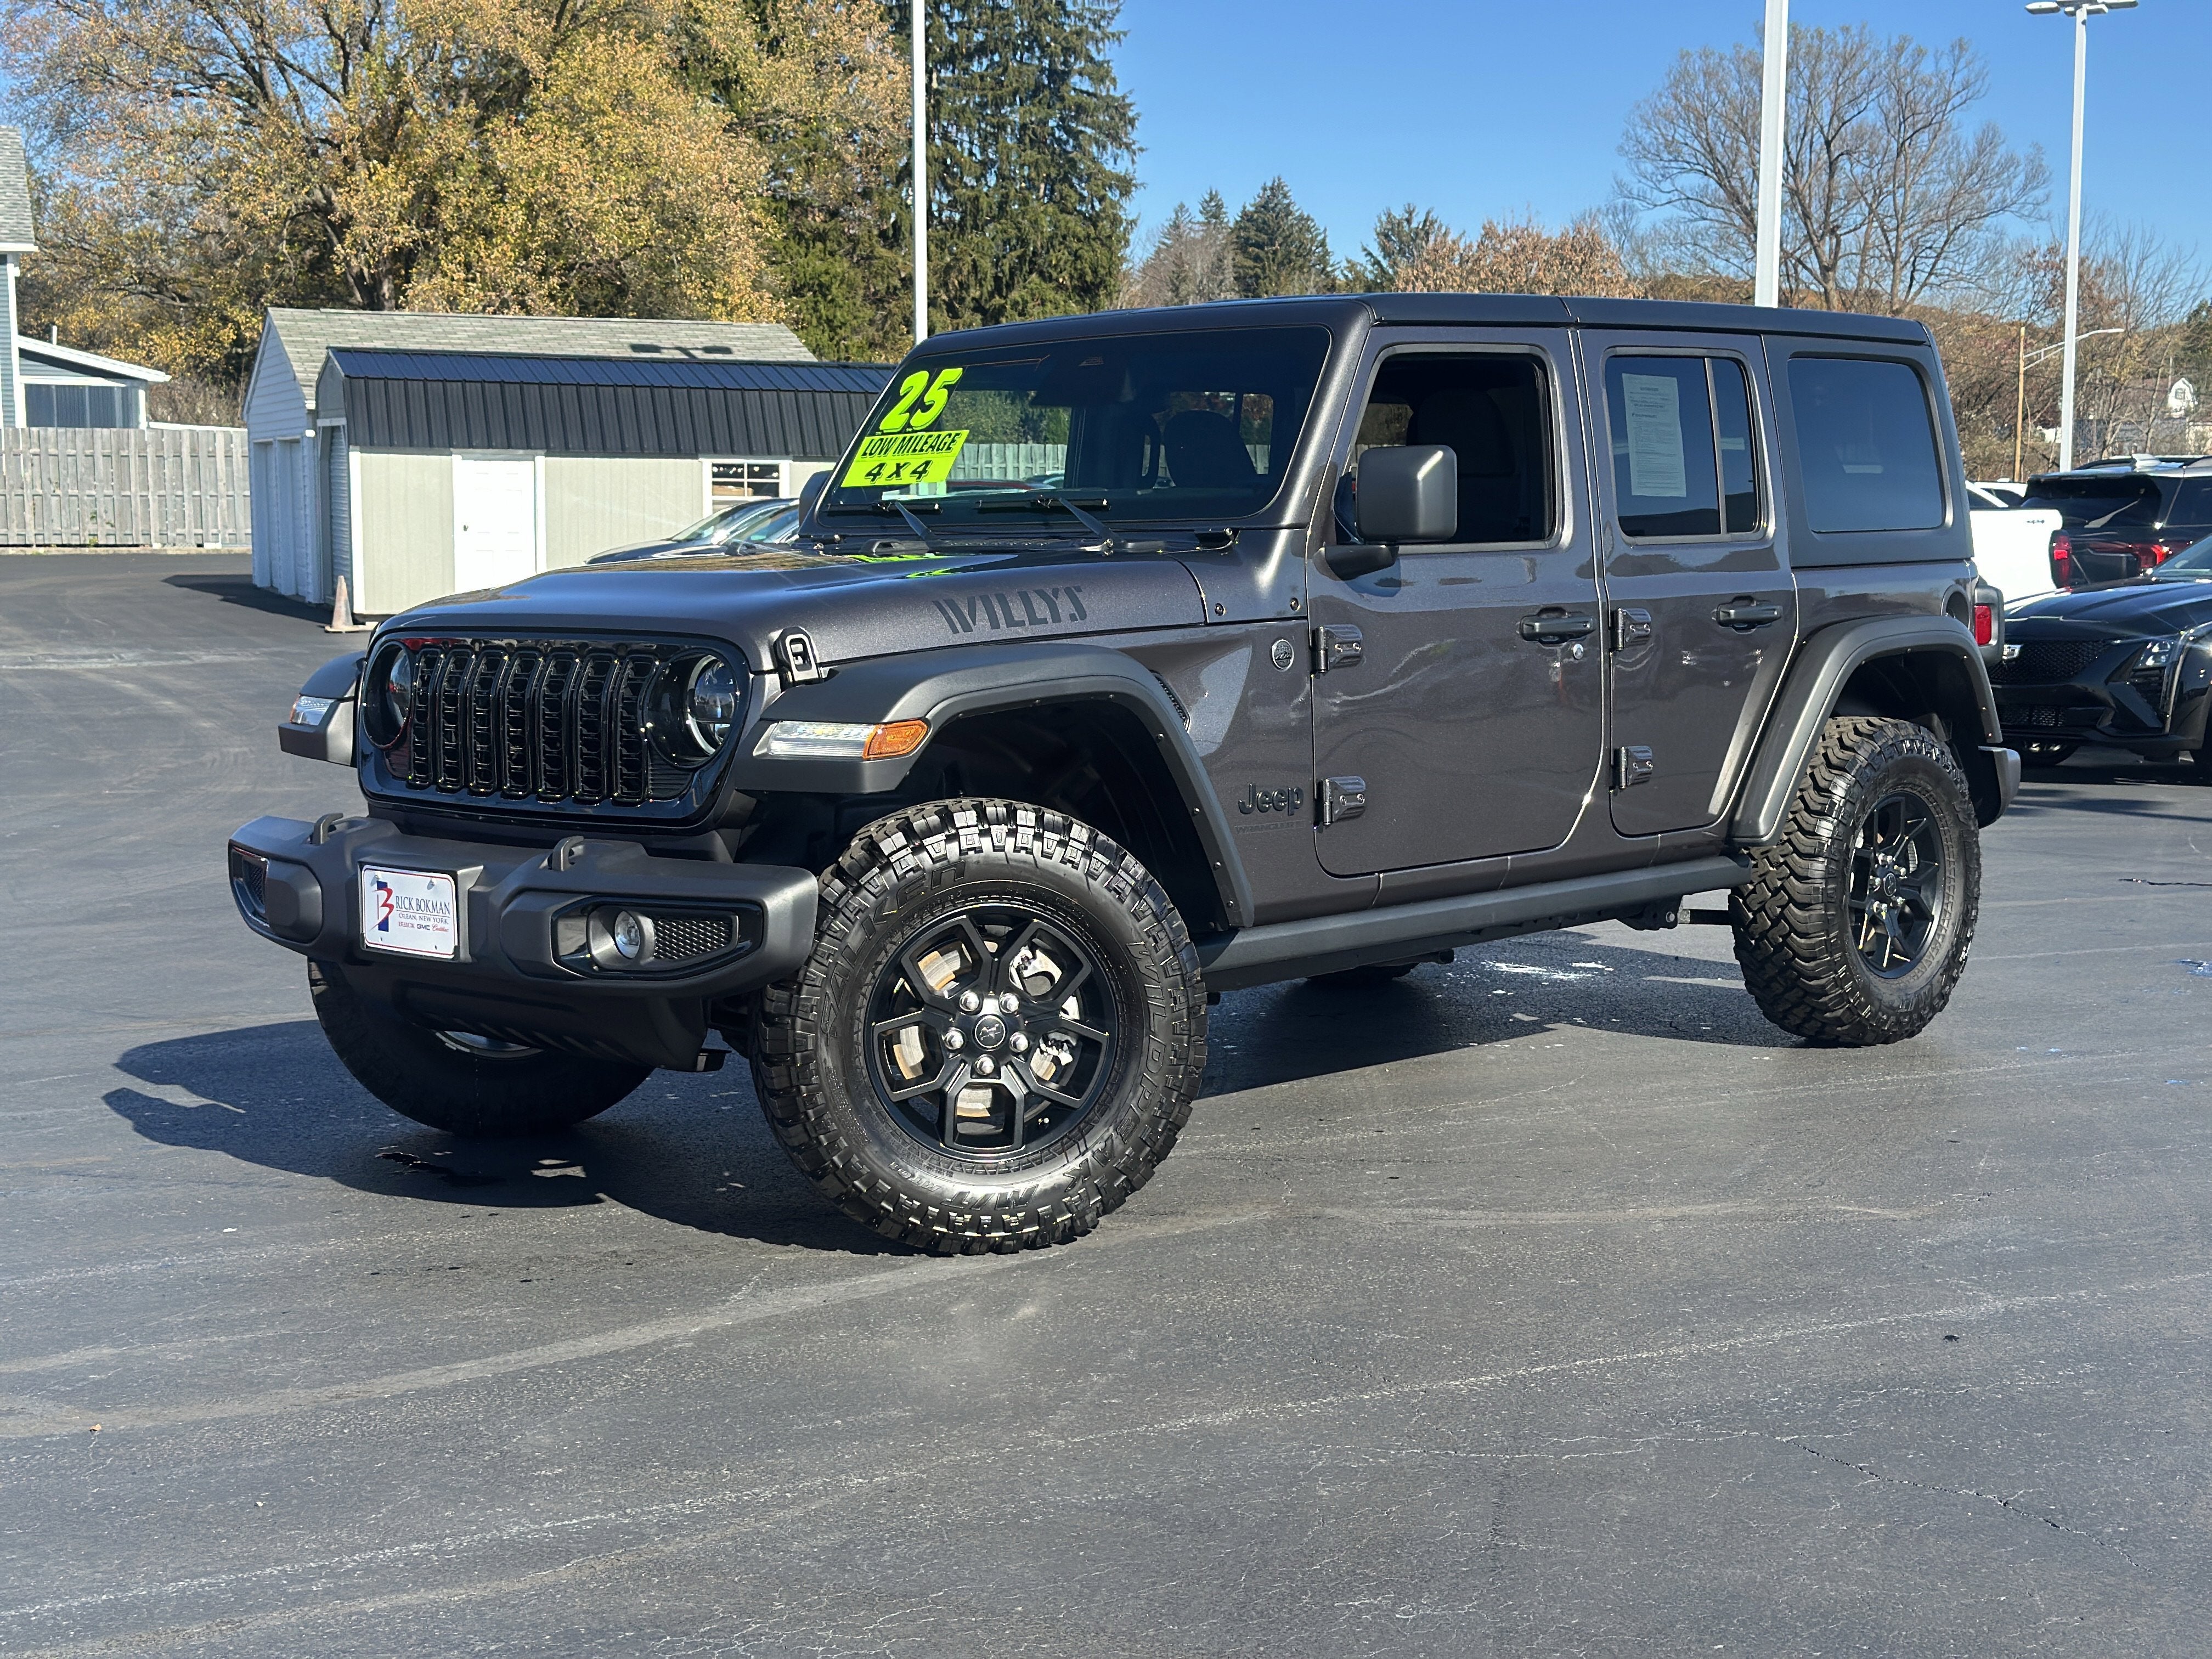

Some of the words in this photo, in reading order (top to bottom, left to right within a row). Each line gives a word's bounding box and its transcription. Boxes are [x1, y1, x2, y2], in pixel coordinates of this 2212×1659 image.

[879, 368, 963, 433] 25
[861, 435, 898, 459] LOW
[893, 432, 962, 456] MILEAGE
[933, 585, 1087, 634] WILLYS
[1238, 783, 1304, 816] Jeep
[396, 895, 414, 911] RICK
[415, 898, 450, 915] BOKMAN
[1063, 941, 1166, 1192] WILDPEAK
